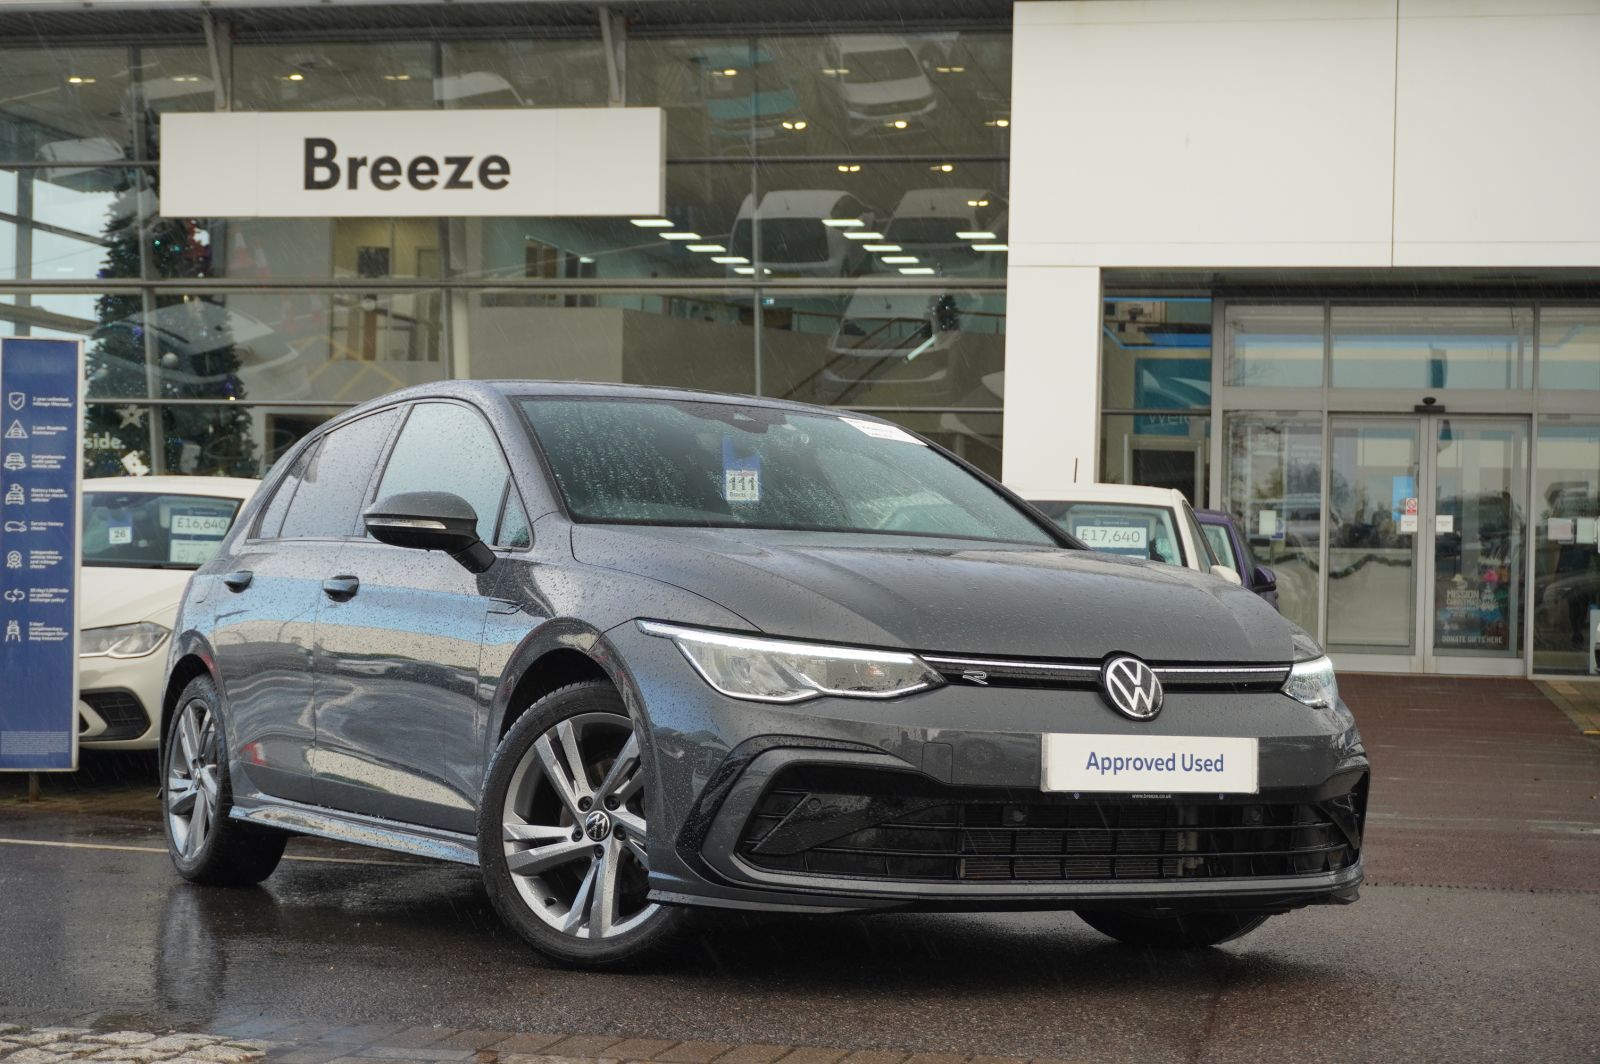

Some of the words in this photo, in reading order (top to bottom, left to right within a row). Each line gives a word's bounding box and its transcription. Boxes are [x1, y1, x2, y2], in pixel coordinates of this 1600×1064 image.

[304, 137, 511, 191] Breeze
[177, 518, 227, 531] £16,640
[1081, 529, 1140, 543] £17,640
[1086, 752, 1176, 775] Approved
[1181, 754, 1224, 772] Used
